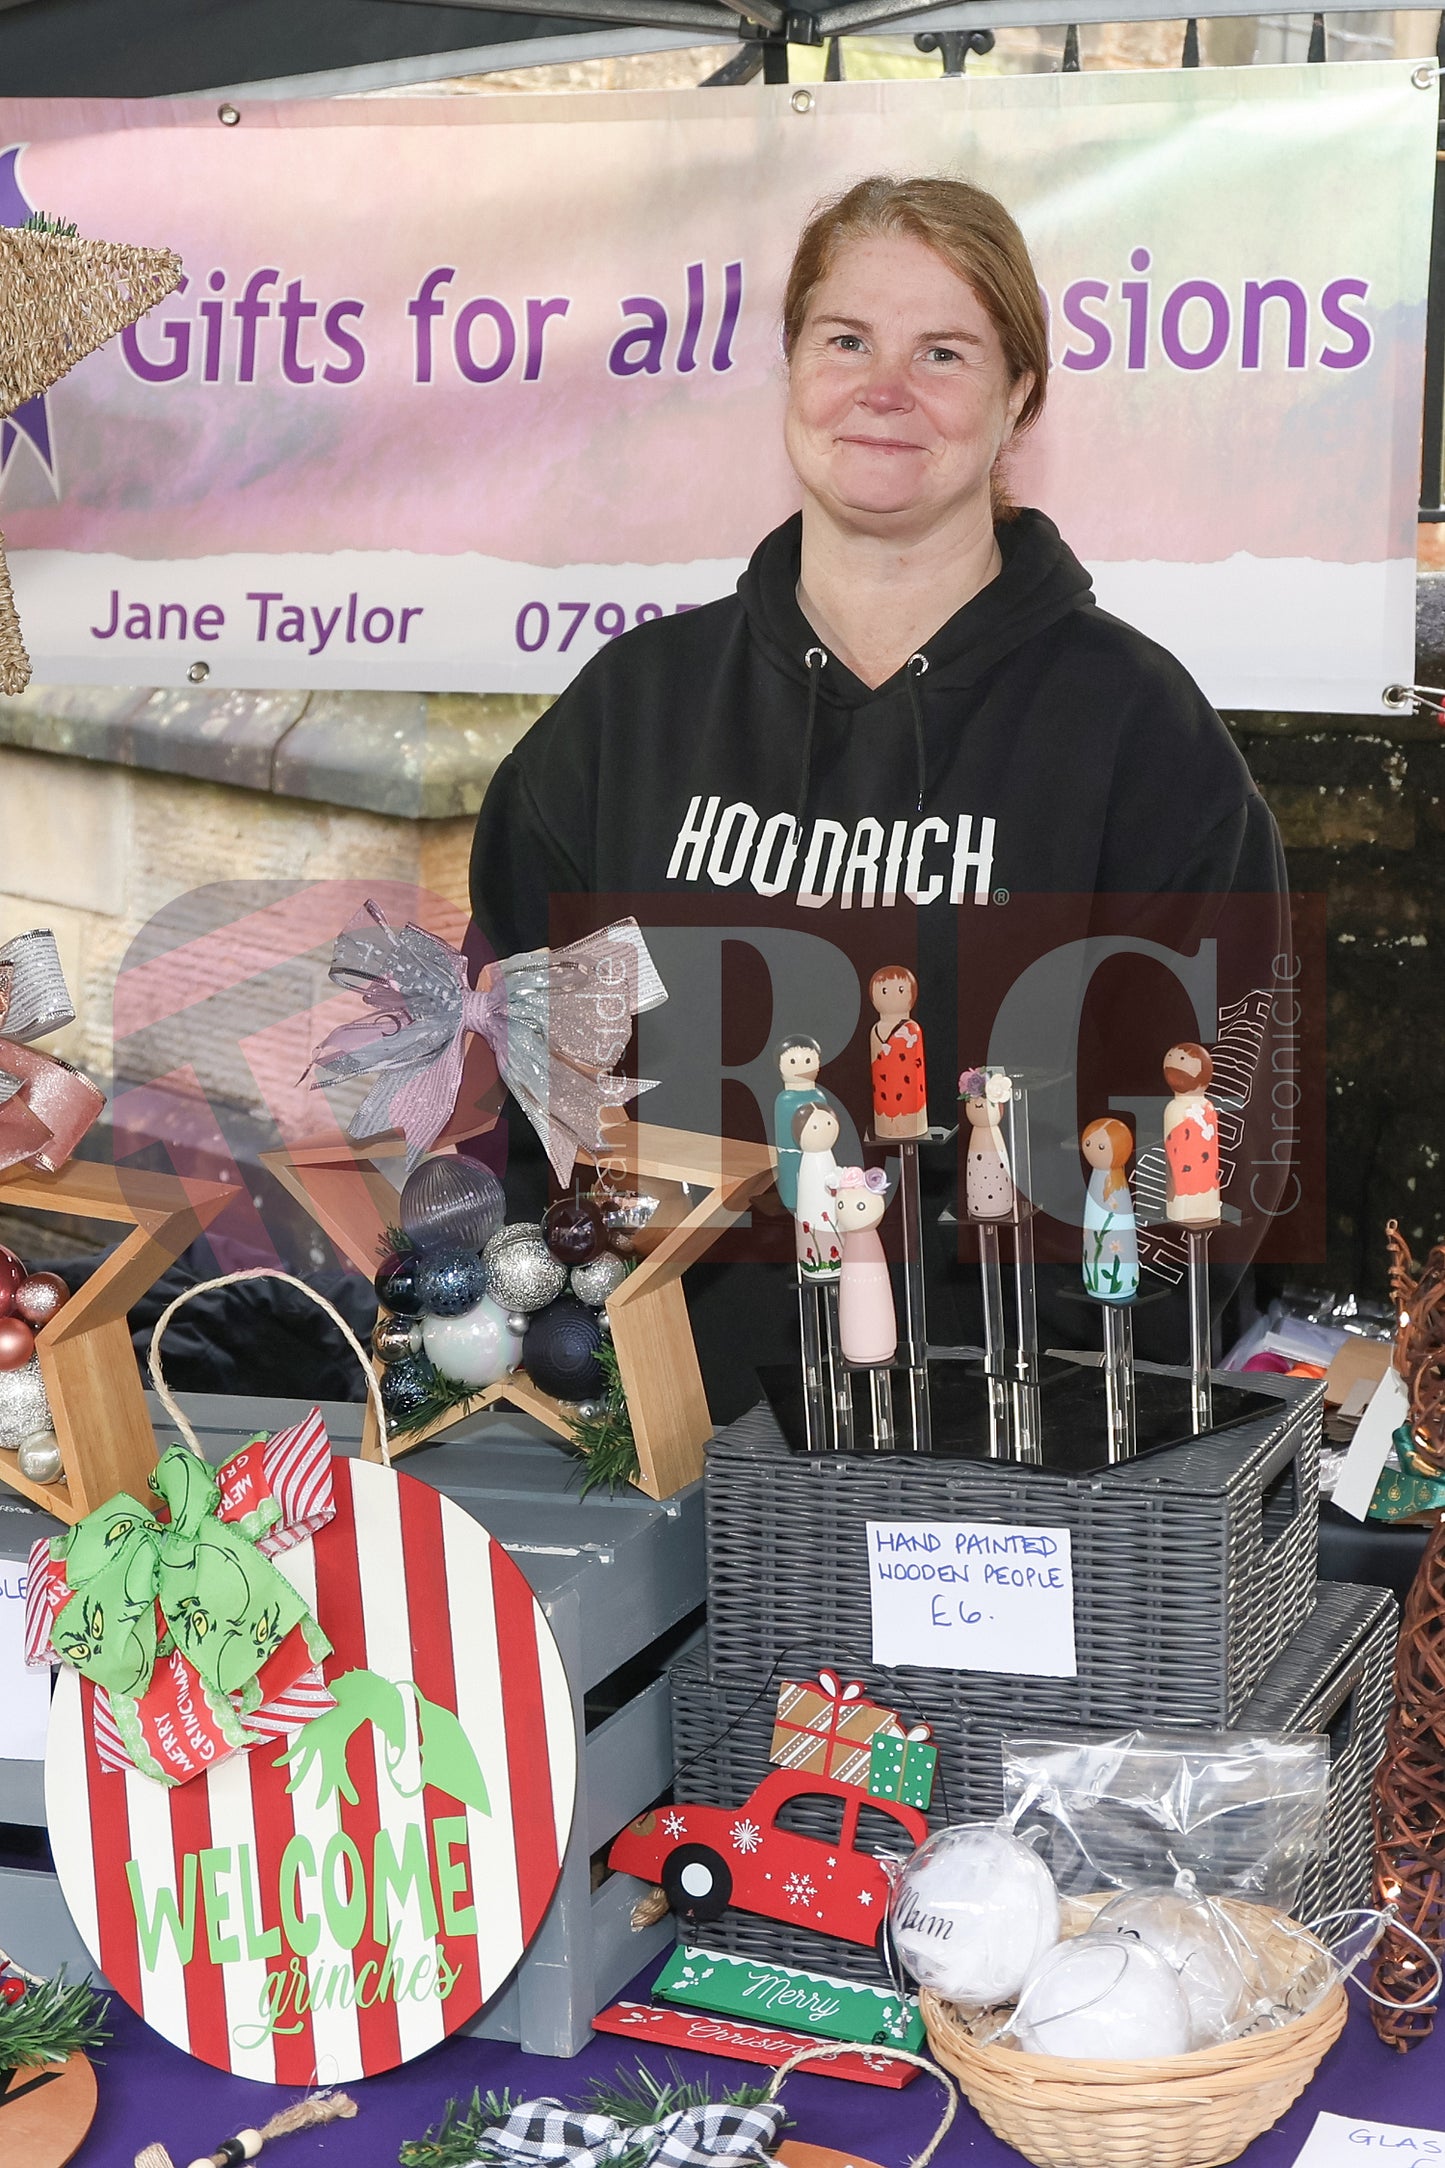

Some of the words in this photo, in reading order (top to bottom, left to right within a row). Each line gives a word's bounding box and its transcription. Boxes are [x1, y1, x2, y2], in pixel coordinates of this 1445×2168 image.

[121, 267, 366, 384] Gifts
[407, 267, 569, 383] for
[608, 262, 743, 376] all
[90, 591, 225, 642] Jane
[246, 591, 423, 655] Taylor
[876, 1530, 941, 1553] HAND
[955, 1533, 1058, 1558] PAINTED
[878, 1563, 969, 1582] WOODEN
[984, 1564, 1065, 1589] PEOPLE
[154, 1713, 195, 1774] MERRY
[124, 1815, 479, 1973] WELCOME
[891, 1880, 954, 1940] Mum
[233, 1919, 463, 2050] grinches
[741, 1970, 840, 2021] Merry
